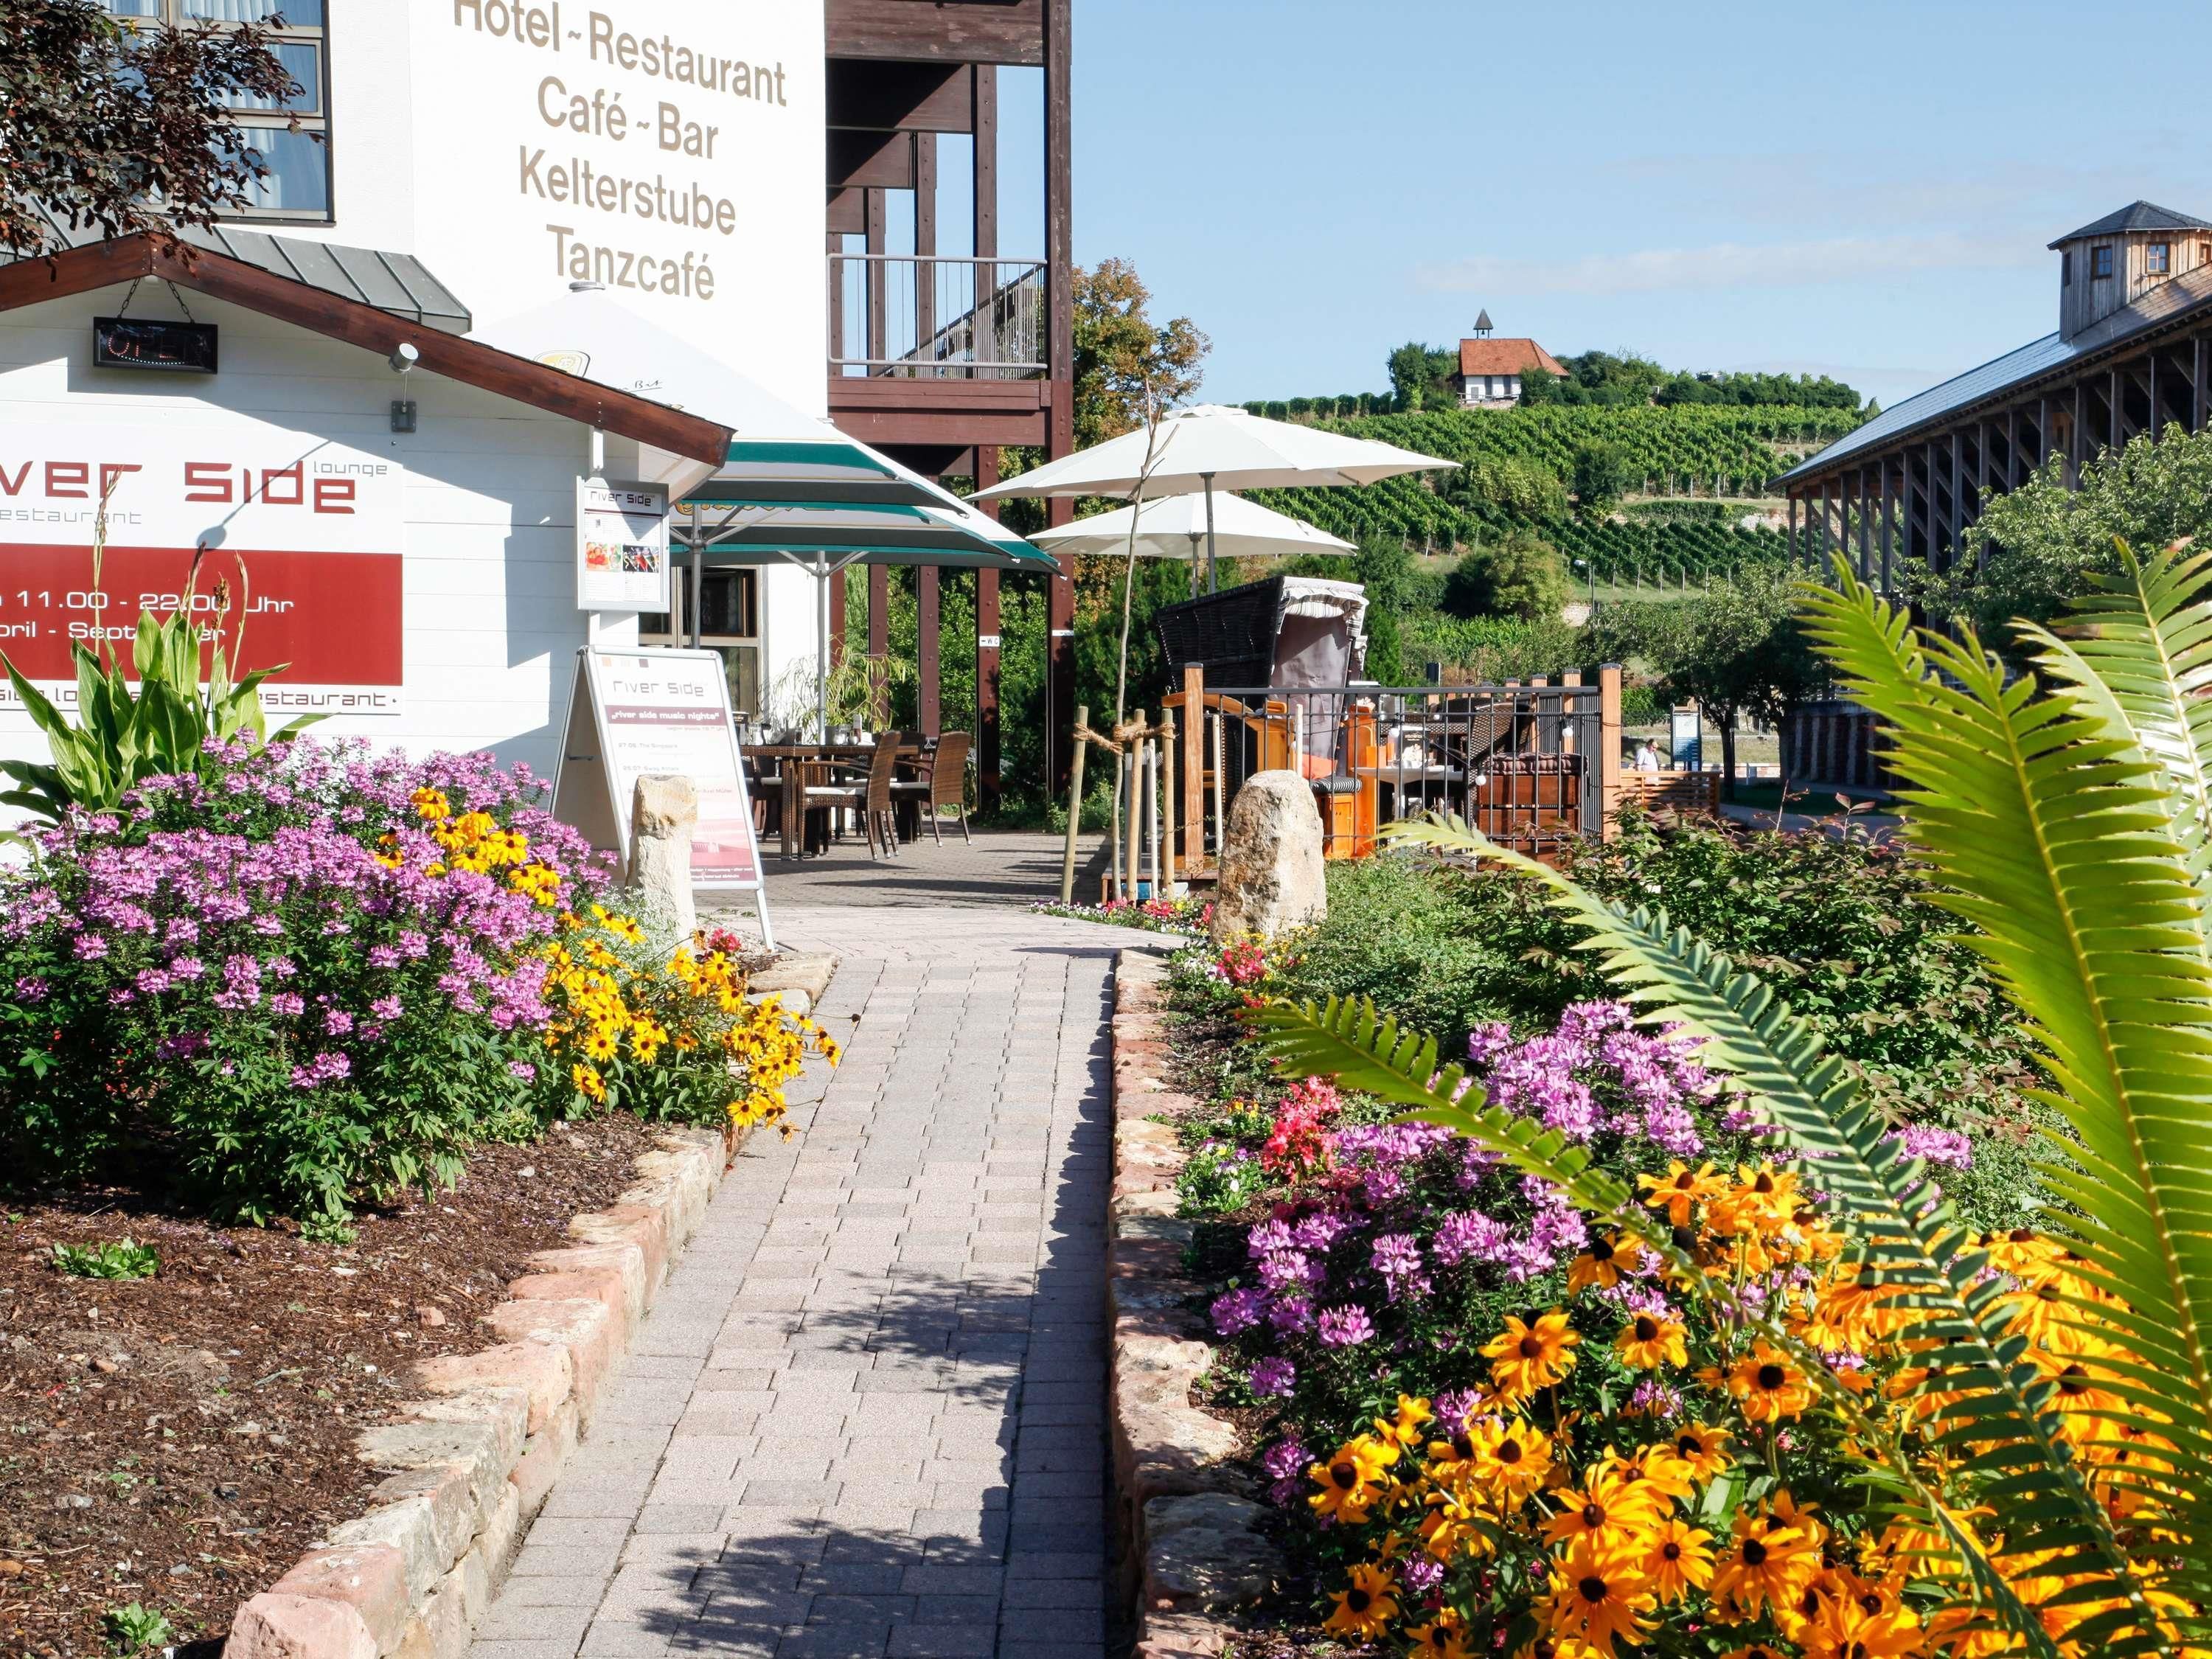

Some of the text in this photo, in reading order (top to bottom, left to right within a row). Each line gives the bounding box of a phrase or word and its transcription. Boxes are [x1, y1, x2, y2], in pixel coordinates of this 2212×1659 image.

[453, 0, 560, 51] Hotel
[589, 11, 787, 106] Restaurant
[538, 76, 626, 141] Café
[658, 101, 719, 159] Bar
[520, 145, 736, 235] Kelterstube
[546, 224, 714, 300] Tanzcafé
[314, 460, 386, 476] lounge
[591, 491, 622, 501] river
[16, 590, 109, 610] 11.00
[68, 621, 226, 642] Septer
[613, 681, 659, 693] river
[258, 691, 386, 706] staurant
[639, 711, 657, 720] side
[660, 712, 686, 720] music
